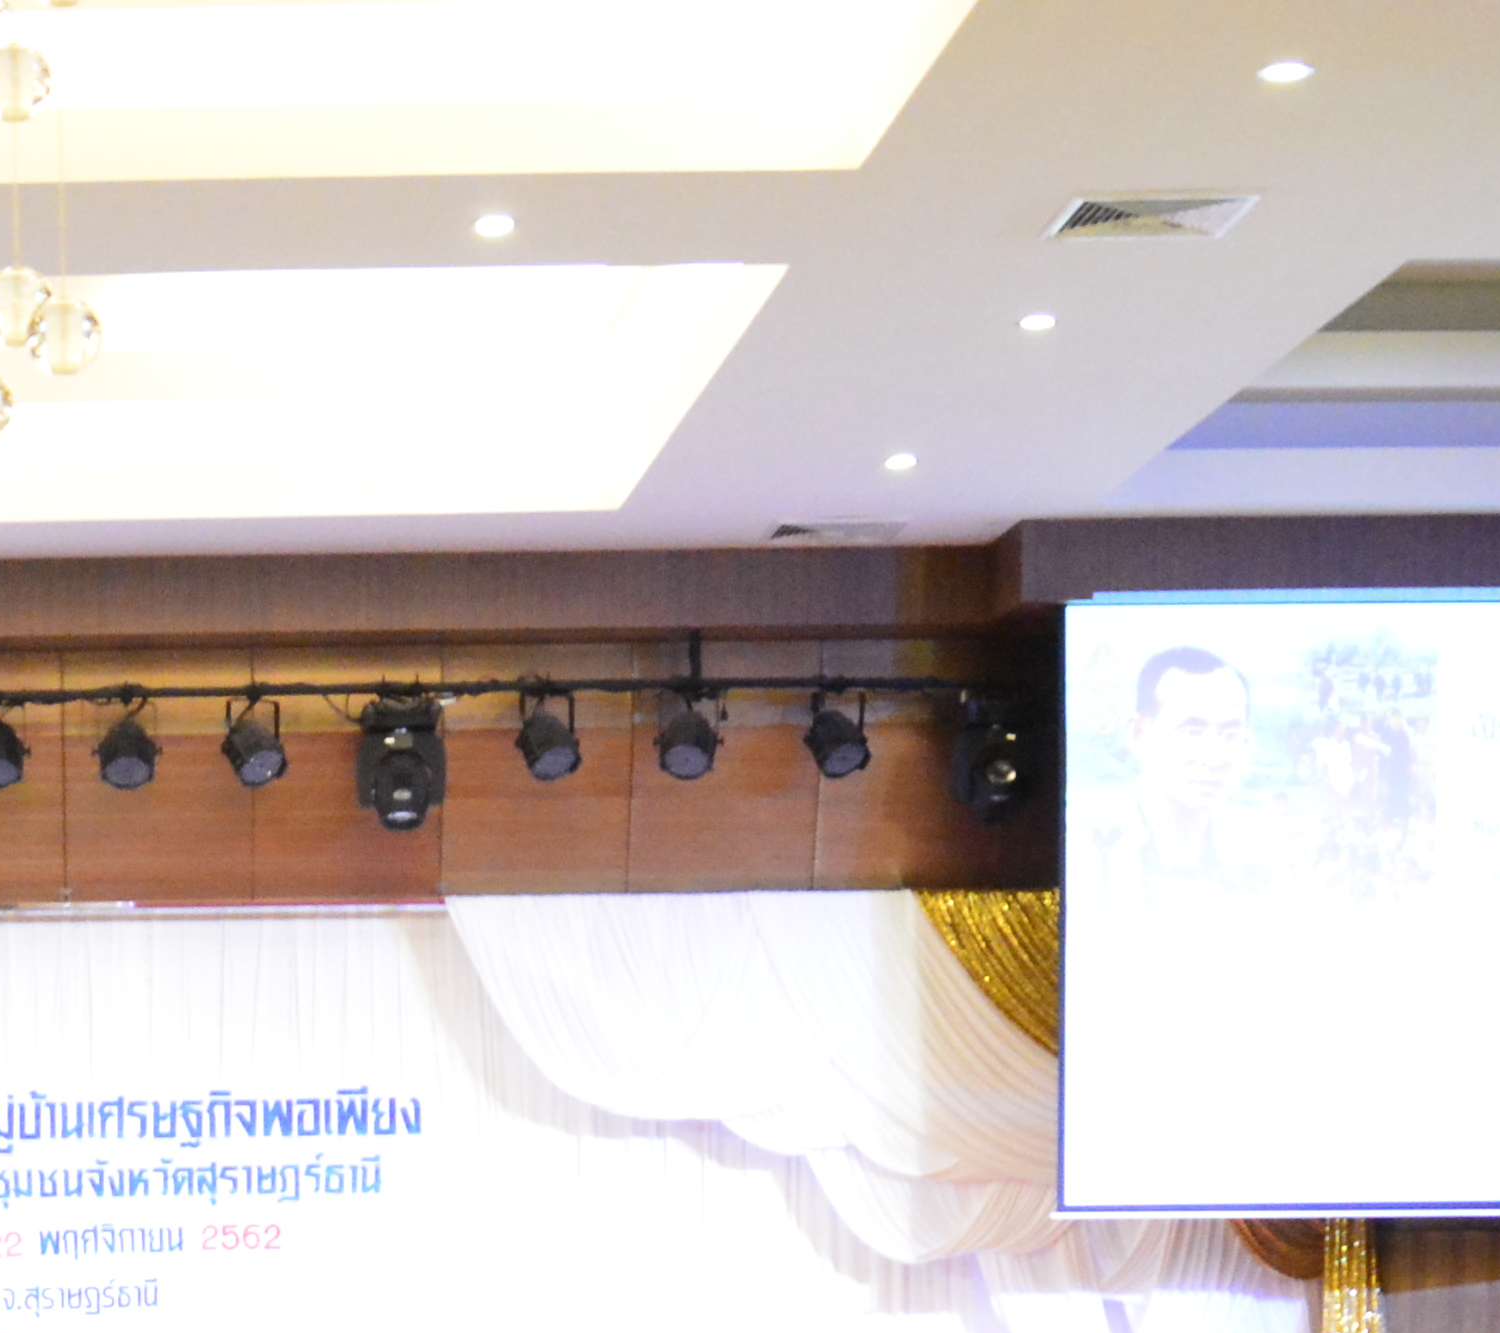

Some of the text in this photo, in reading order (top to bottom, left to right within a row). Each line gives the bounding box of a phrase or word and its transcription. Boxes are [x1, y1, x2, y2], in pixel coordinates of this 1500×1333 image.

[39, 1223, 184, 1260] พฤศจิกายน
[202, 1224, 282, 1251] 2562
